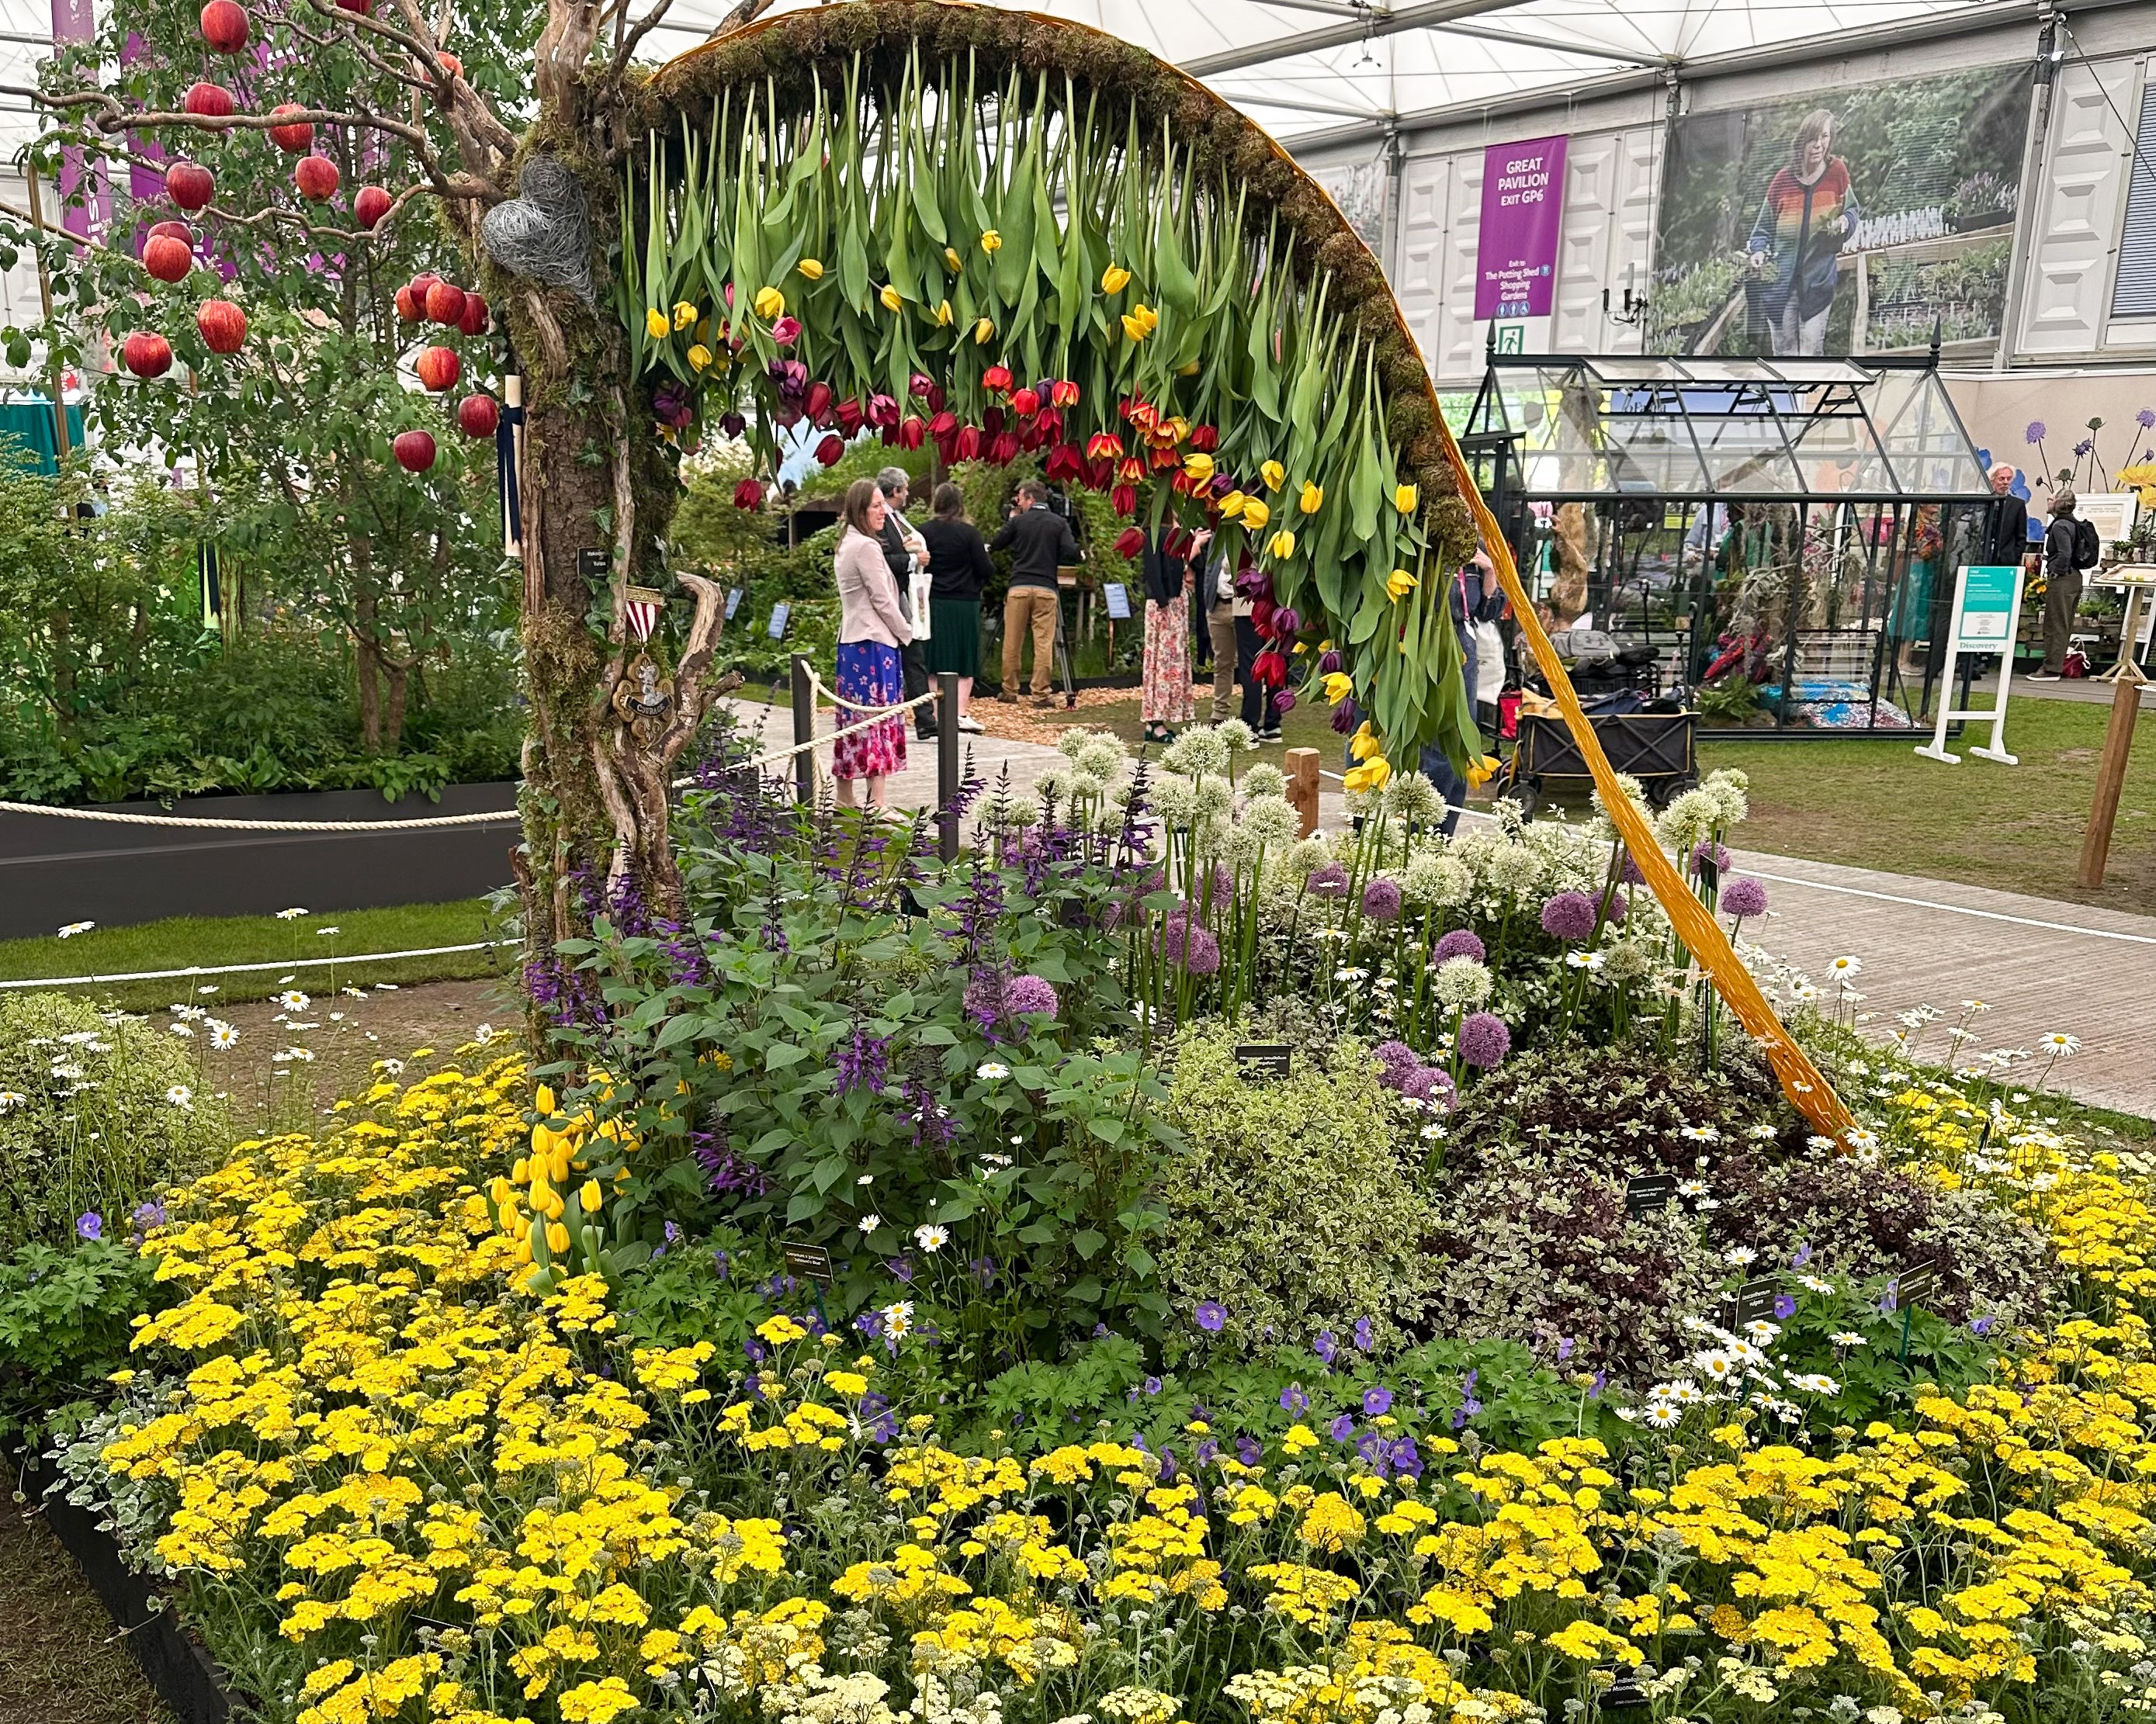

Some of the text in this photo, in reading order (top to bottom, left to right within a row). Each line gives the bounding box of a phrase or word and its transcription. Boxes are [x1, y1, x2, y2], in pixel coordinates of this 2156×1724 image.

[1506, 157, 1543, 174] GREAT
[1498, 171, 1549, 191] PAVILION
[1501, 189, 1544, 206] EXIT GP6
[1485, 272, 1498, 280] The
[1523, 267, 1540, 278] Shed
[1499, 280, 1530, 291] Shopping
[1960, 642, 1998, 650] Discovery
